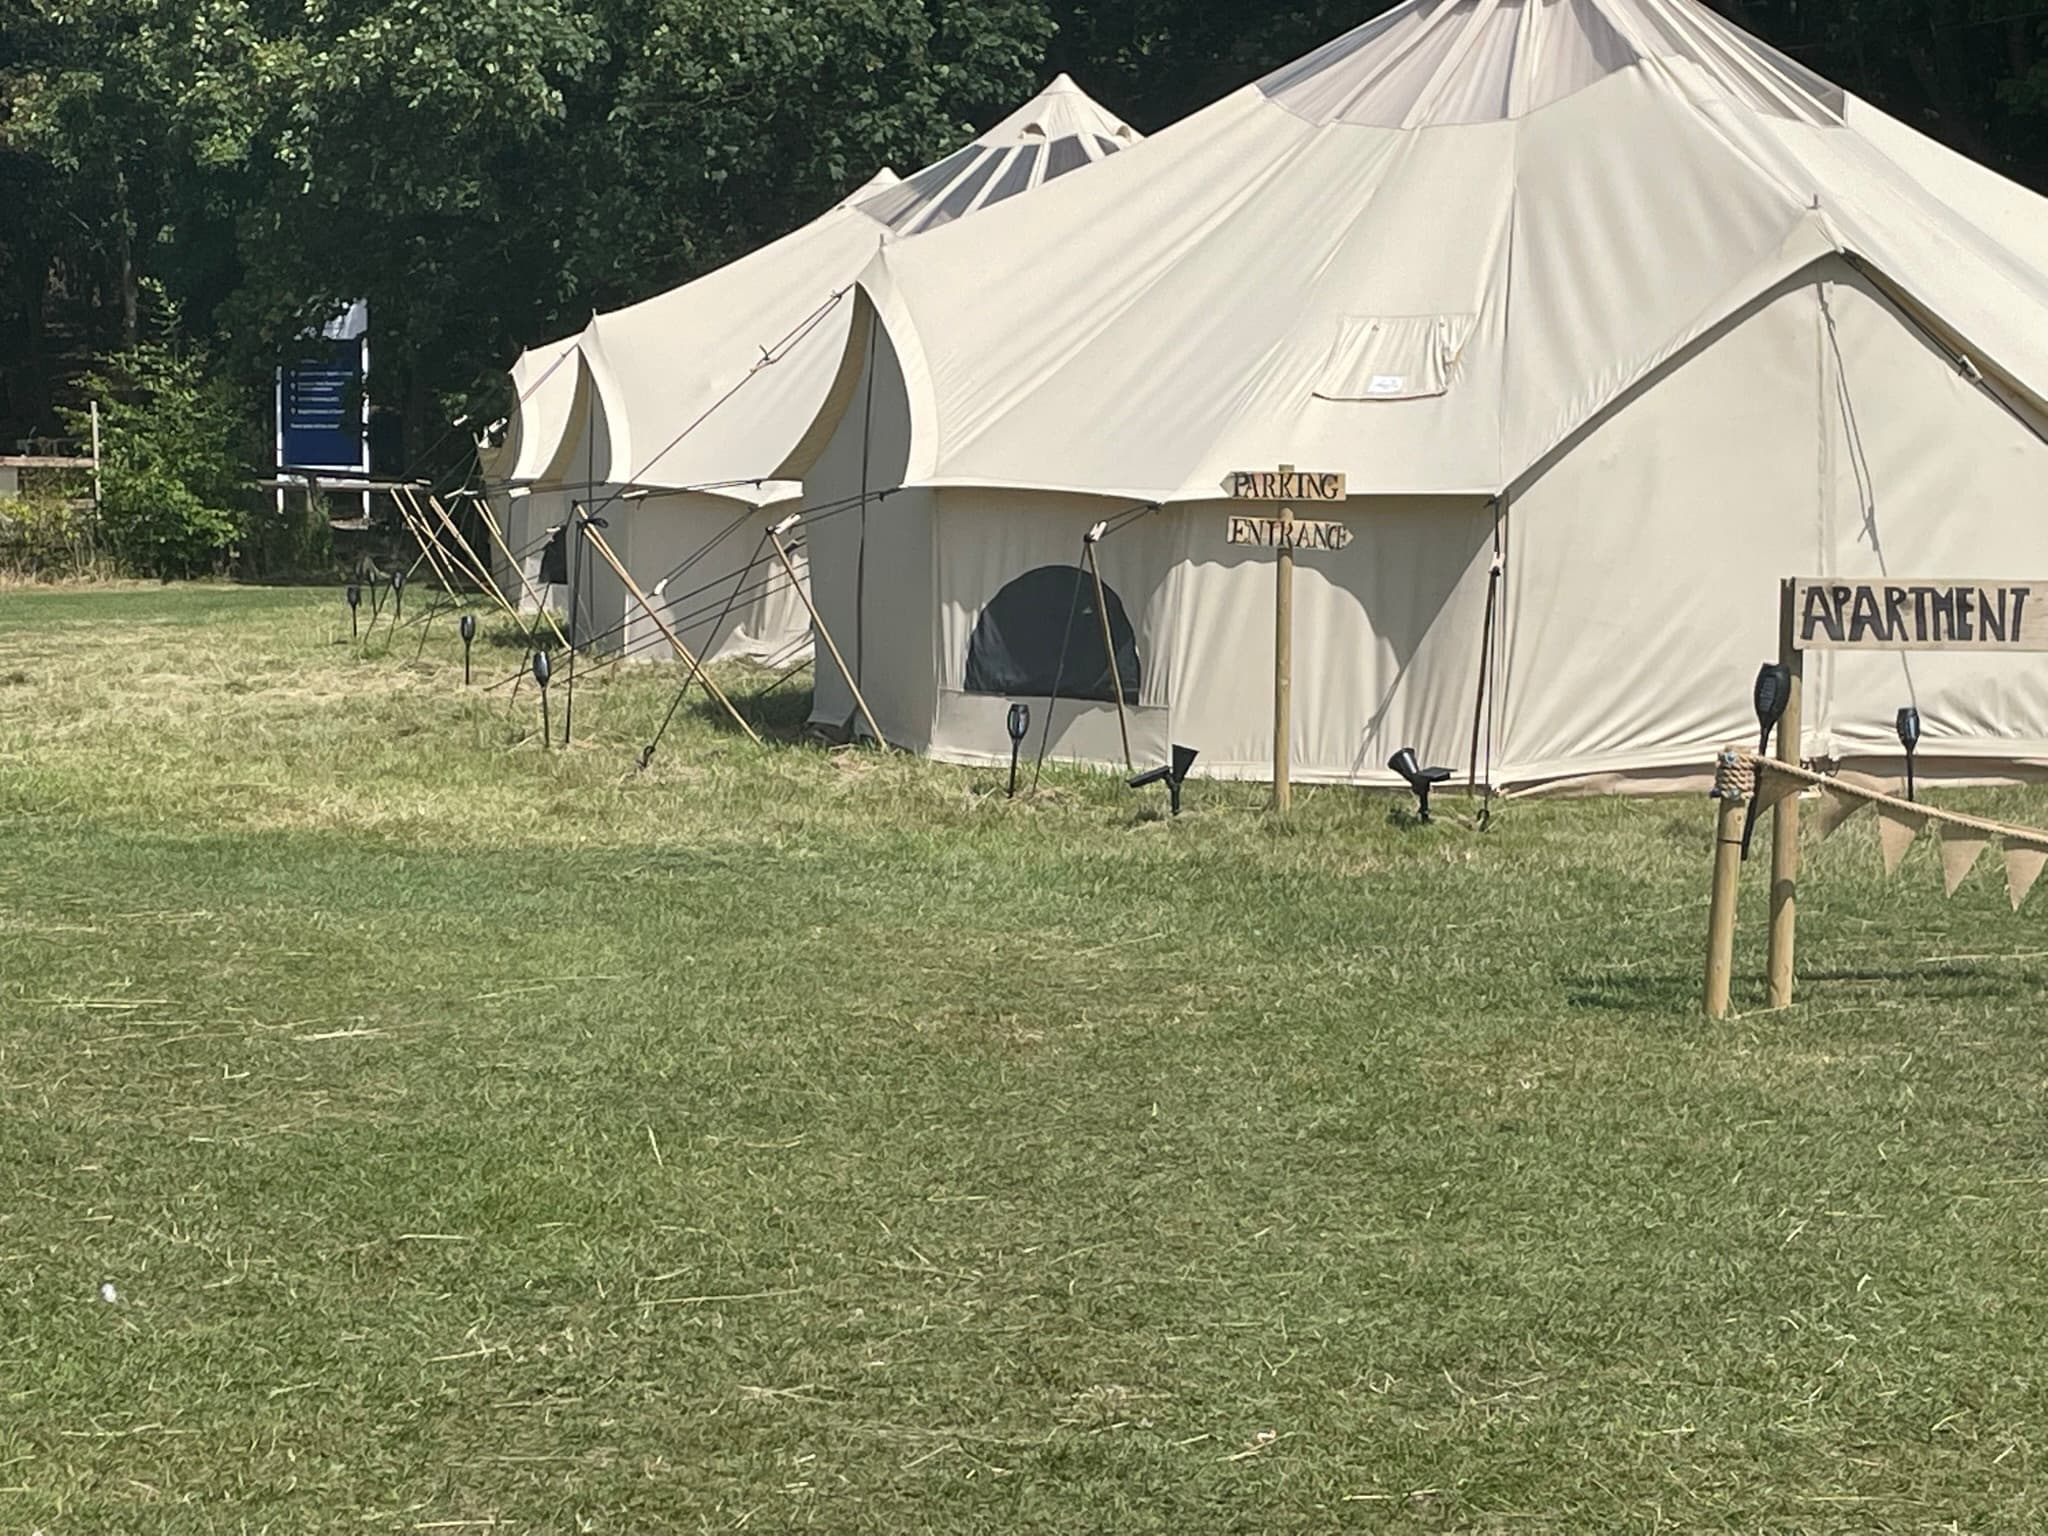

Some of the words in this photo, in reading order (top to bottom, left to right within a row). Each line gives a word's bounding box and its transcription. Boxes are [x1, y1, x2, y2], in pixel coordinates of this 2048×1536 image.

[1232, 472, 1339, 500] PARKING
[1231, 518, 1347, 551] ENTRANCE
[1800, 586, 2030, 642] APARTMENT
